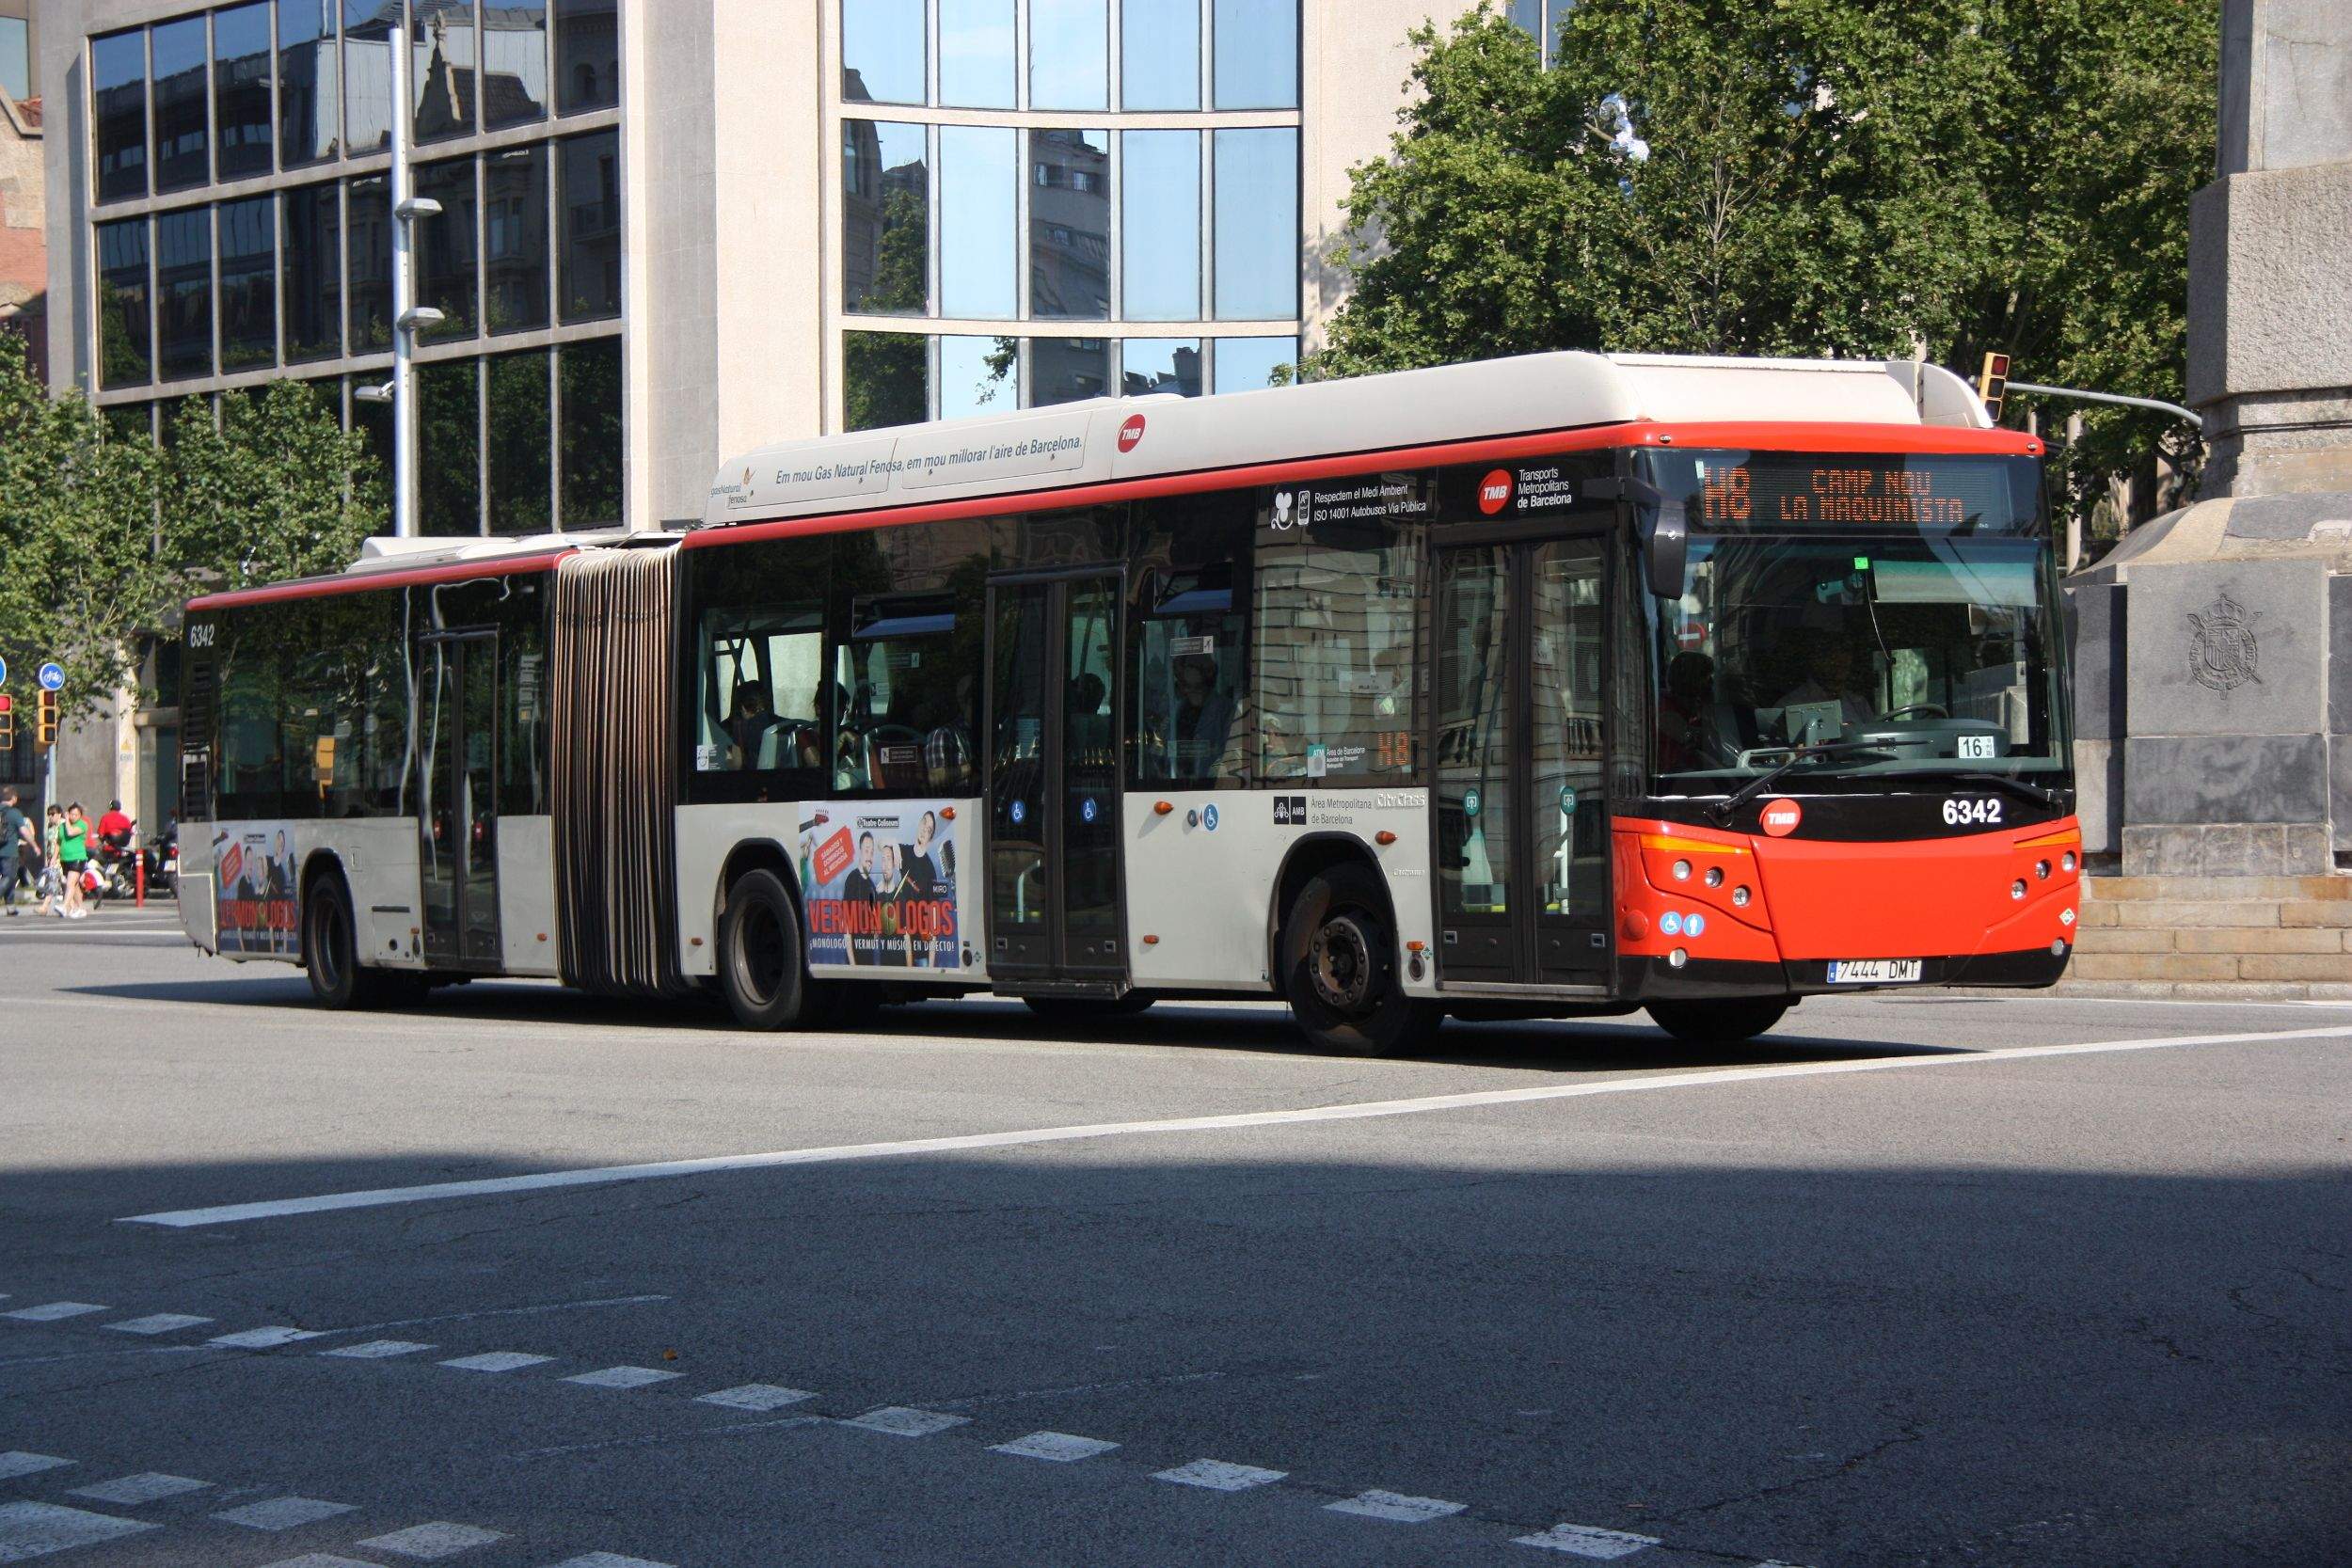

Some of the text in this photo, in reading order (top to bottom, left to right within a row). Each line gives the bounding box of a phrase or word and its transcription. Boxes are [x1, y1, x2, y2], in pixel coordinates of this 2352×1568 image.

[1121, 429, 1141, 440] TMB
[775, 436, 1083, 484] Em mou Gas Natural Fenosa, em mou millorar l'aire de Barcelona.
[1518, 467, 1559, 482] Transports
[1518, 479, 1569, 496] Metropolitans
[1812, 469, 1932, 496] CAMP NOU
[1314, 483, 1408, 505] Respectem el Medi Ambient
[1484, 485, 1508, 500] TMB
[728, 495, 748, 508] fenosa
[1518, 494, 1572, 508] de Barcelona
[1313, 509, 1327, 522] ISO
[1329, 508, 1349, 519] 14001
[1350, 506, 1387, 518] Autobusos
[1400, 500, 1427, 514] Pública
[1780, 495, 1965, 523] LA MAQUINISTA
[190, 624, 215, 649] 6342
[1312, 749, 1325, 757] ATM
[1963, 737, 1982, 757] 16
[1292, 806, 1305, 816] AMB
[1327, 798, 1373, 811] Metropolitana
[1943, 799, 2002, 825] 6342
[1311, 814, 1353, 825] de Barcelona
[1768, 813, 1796, 825] TMB
[854, 939, 880, 950] VERMUT
[881, 939, 885, 950] Y
[914, 941, 922, 951] EN
[1840, 960, 1879, 979] 7444
[1888, 959, 1918, 979] DMT
